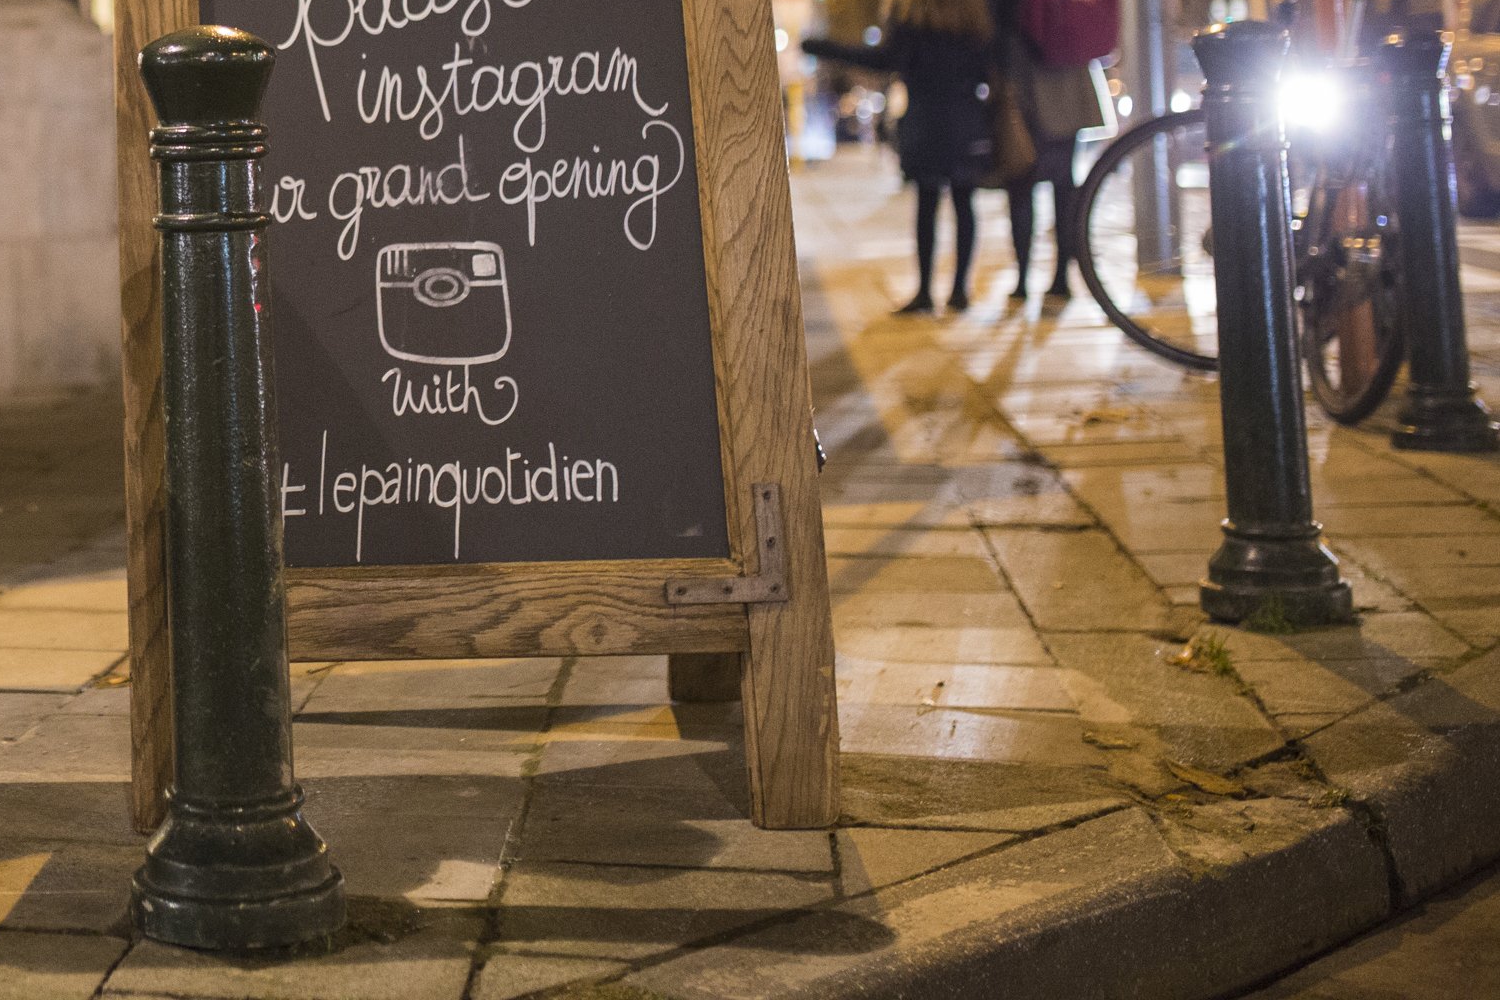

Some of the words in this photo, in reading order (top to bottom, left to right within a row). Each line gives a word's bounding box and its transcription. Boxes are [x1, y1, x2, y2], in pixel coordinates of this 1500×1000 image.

[356, 42, 669, 152] instagram
[328, 134, 490, 260] grand
[498, 120, 685, 250] opening
[381, 363, 518, 425] with
